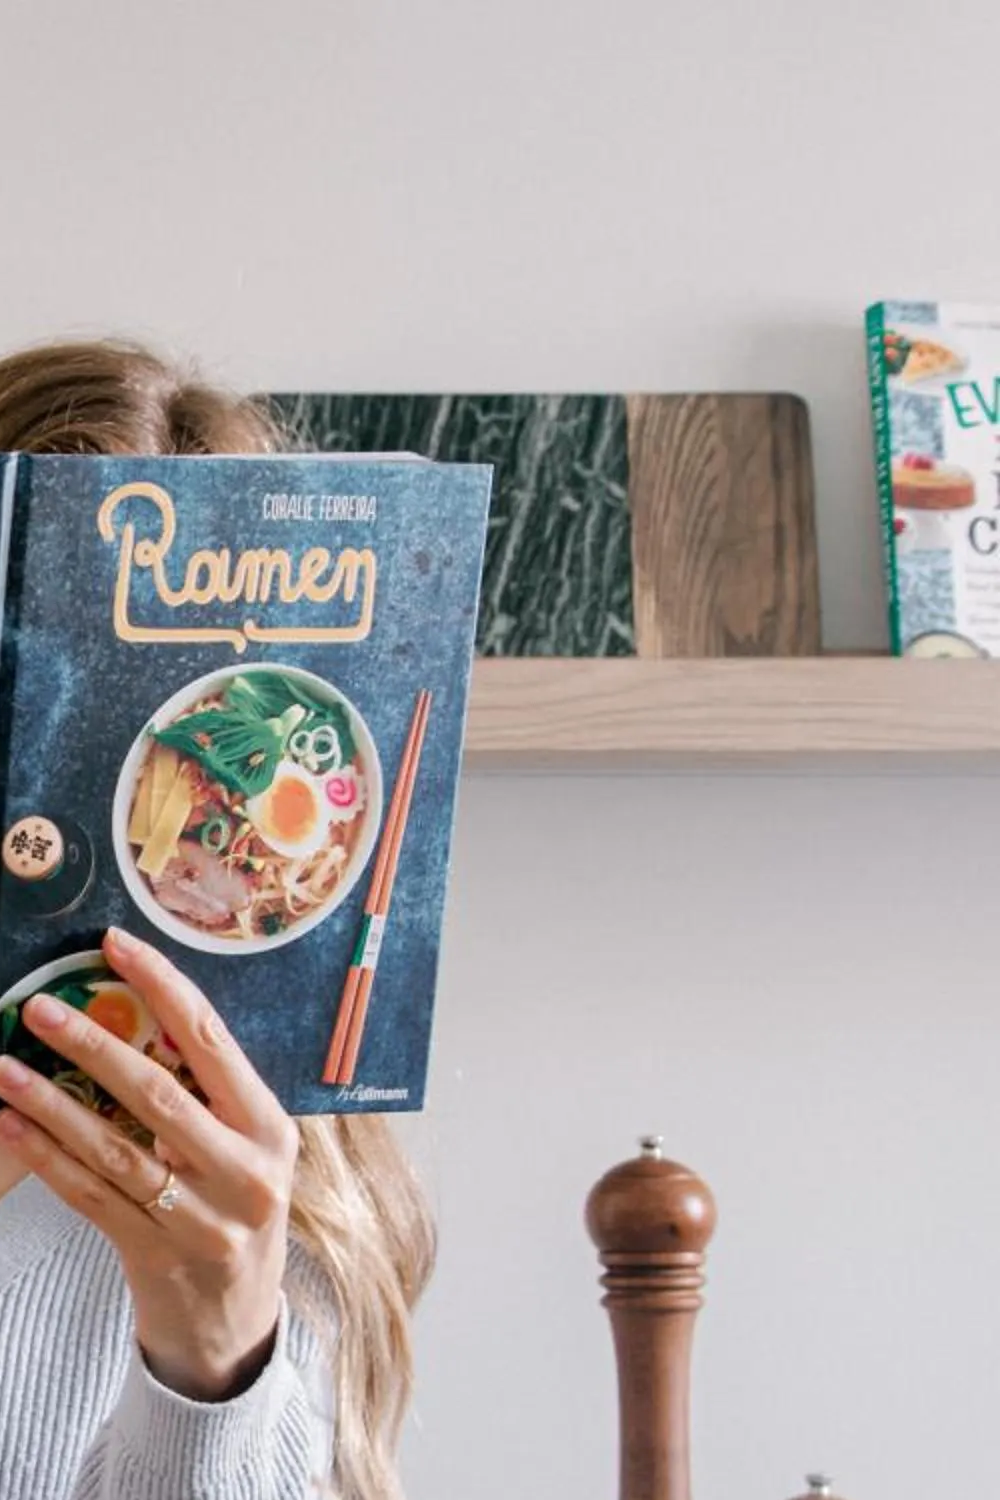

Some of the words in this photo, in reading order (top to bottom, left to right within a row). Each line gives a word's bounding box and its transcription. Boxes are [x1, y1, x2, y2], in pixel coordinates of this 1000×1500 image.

[263, 493, 315, 521] CORALIE
[319, 495, 378, 525] FERREIRA
[97, 482, 376, 642] Ramen
